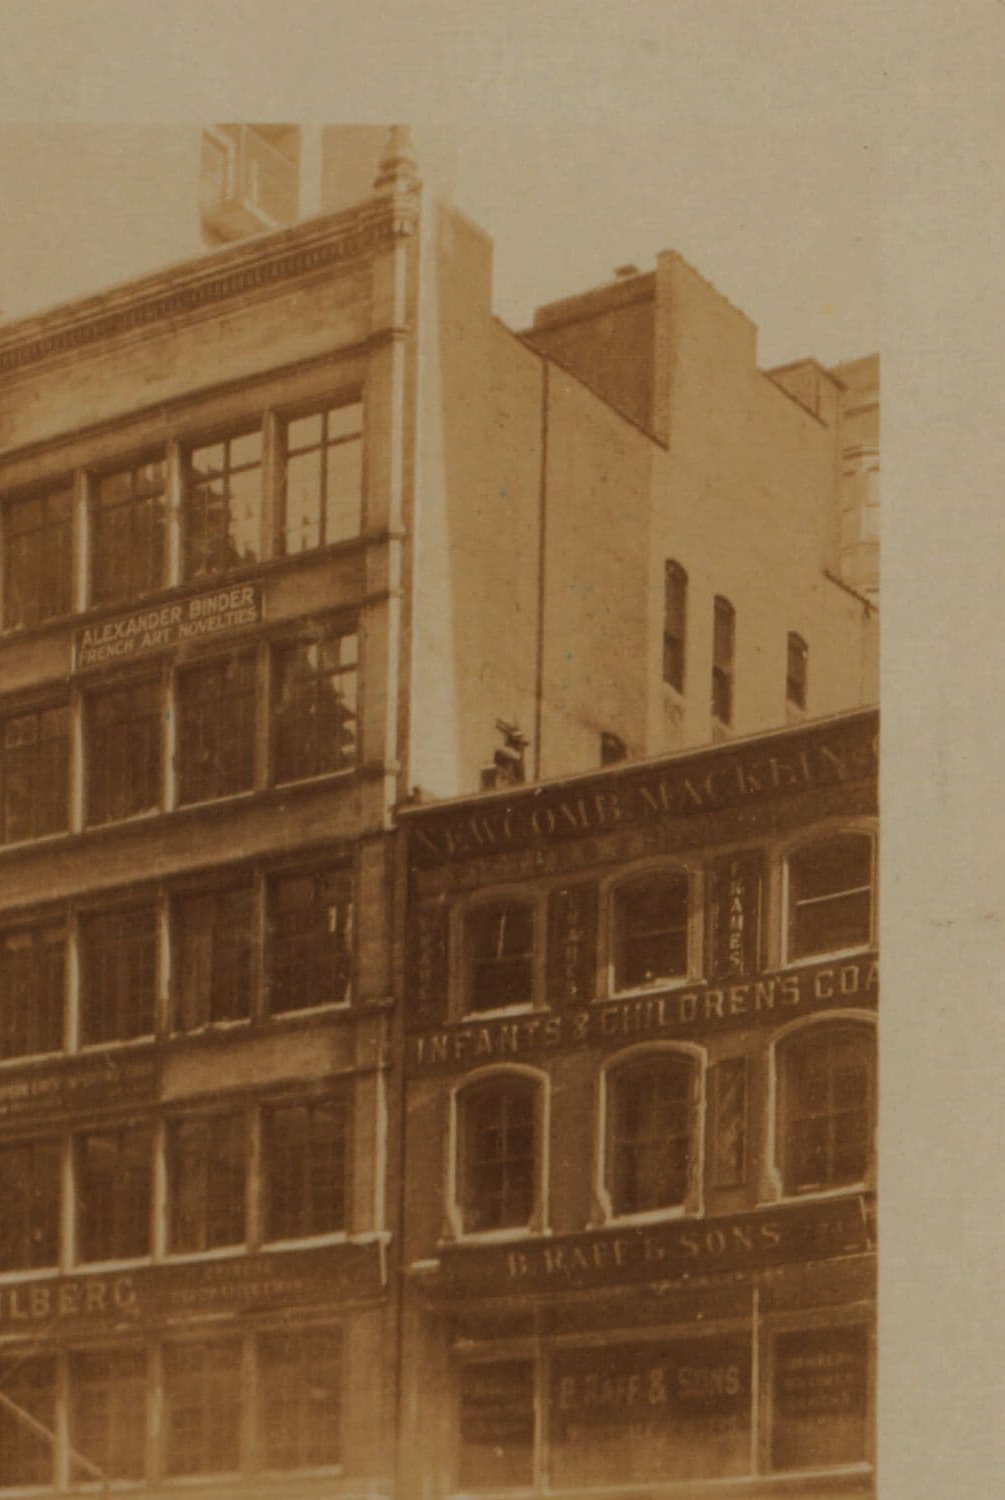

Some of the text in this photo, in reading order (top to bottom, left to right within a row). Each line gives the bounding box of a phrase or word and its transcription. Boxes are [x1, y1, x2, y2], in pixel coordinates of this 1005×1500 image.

[78, 606, 258, 666] FRENCH ART NOVELTIES
[81, 586, 254, 648] ALEXANDER BINDER
[417, 1018, 561, 1065] INFANTS
[601, 975, 800, 1034] CHILDREN'S
[680, 1222, 782, 1257] SONS
